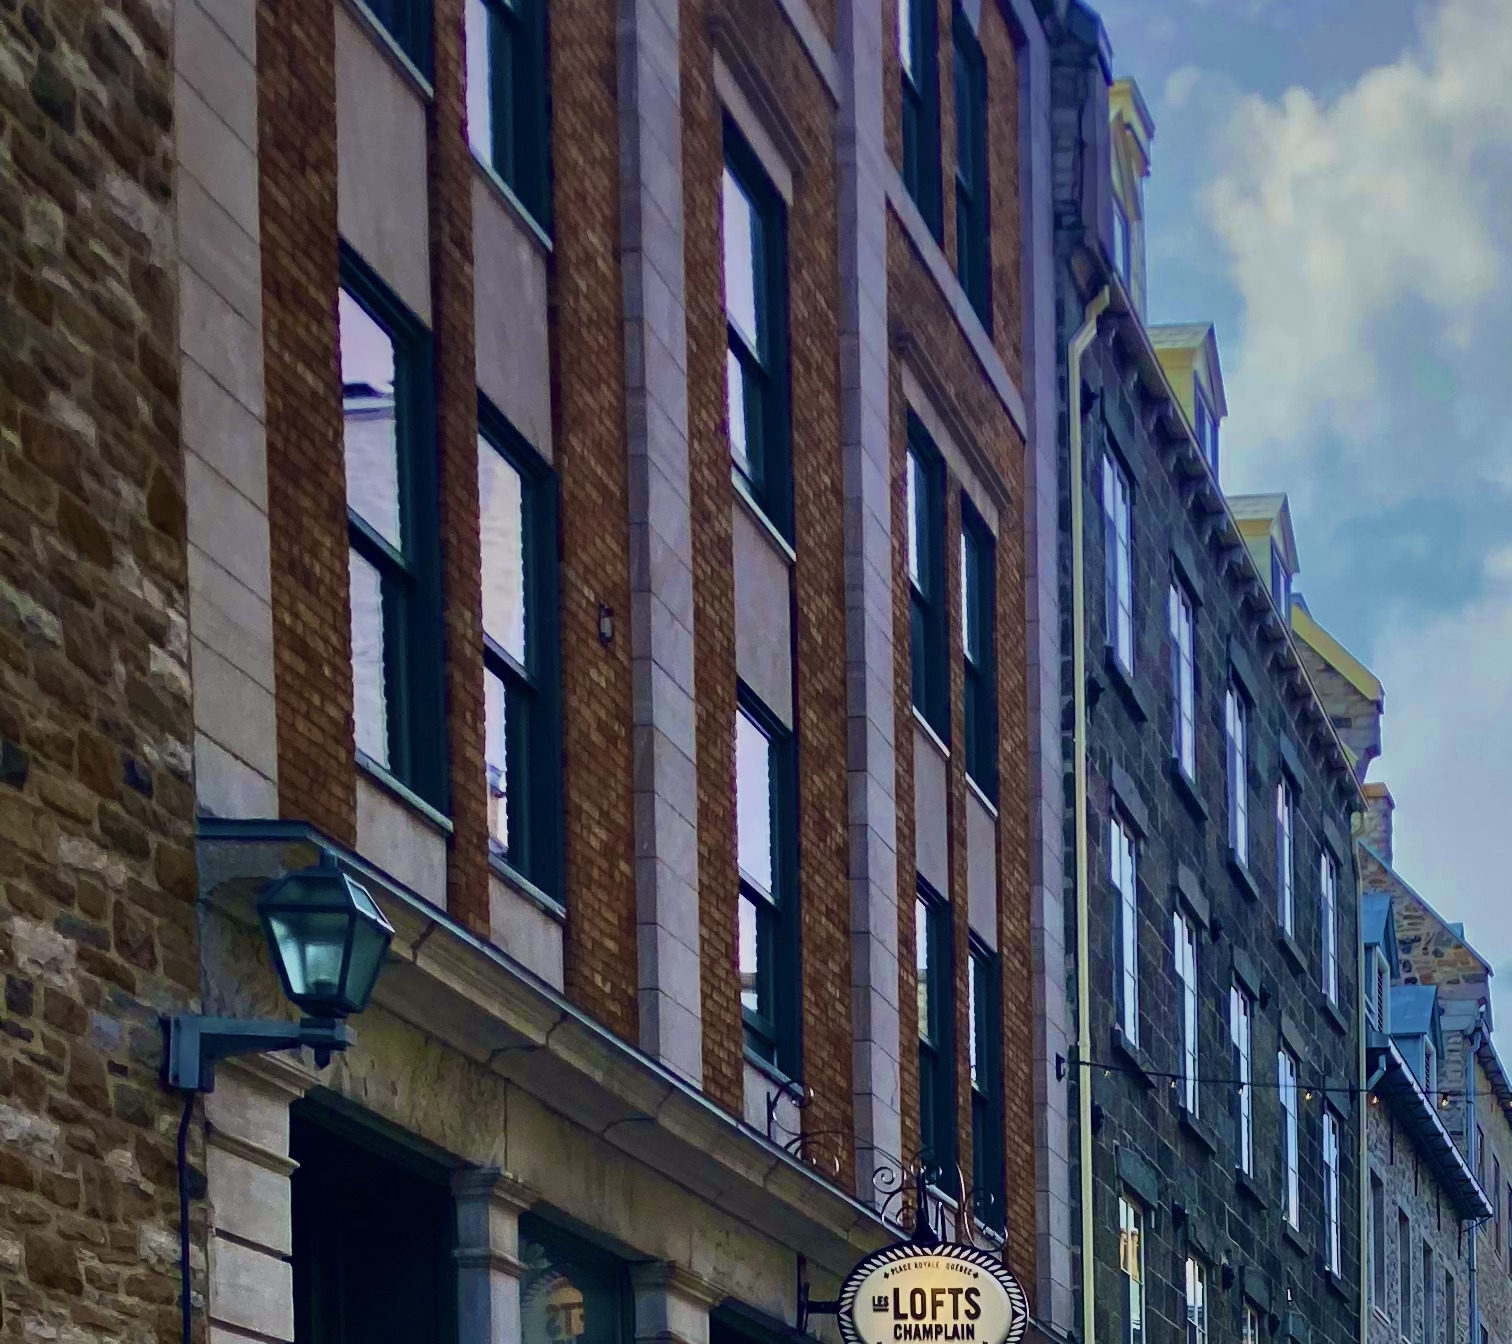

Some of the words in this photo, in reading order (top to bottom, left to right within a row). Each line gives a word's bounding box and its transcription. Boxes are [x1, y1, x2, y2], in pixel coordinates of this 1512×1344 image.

[890, 1262, 911, 1275] PLACE
[914, 1261, 940, 1270] ROYALE
[872, 1295, 889, 1309] LES
[893, 1287, 981, 1320] LOFTS
[893, 1324, 975, 1341] CHAMPLAIN
